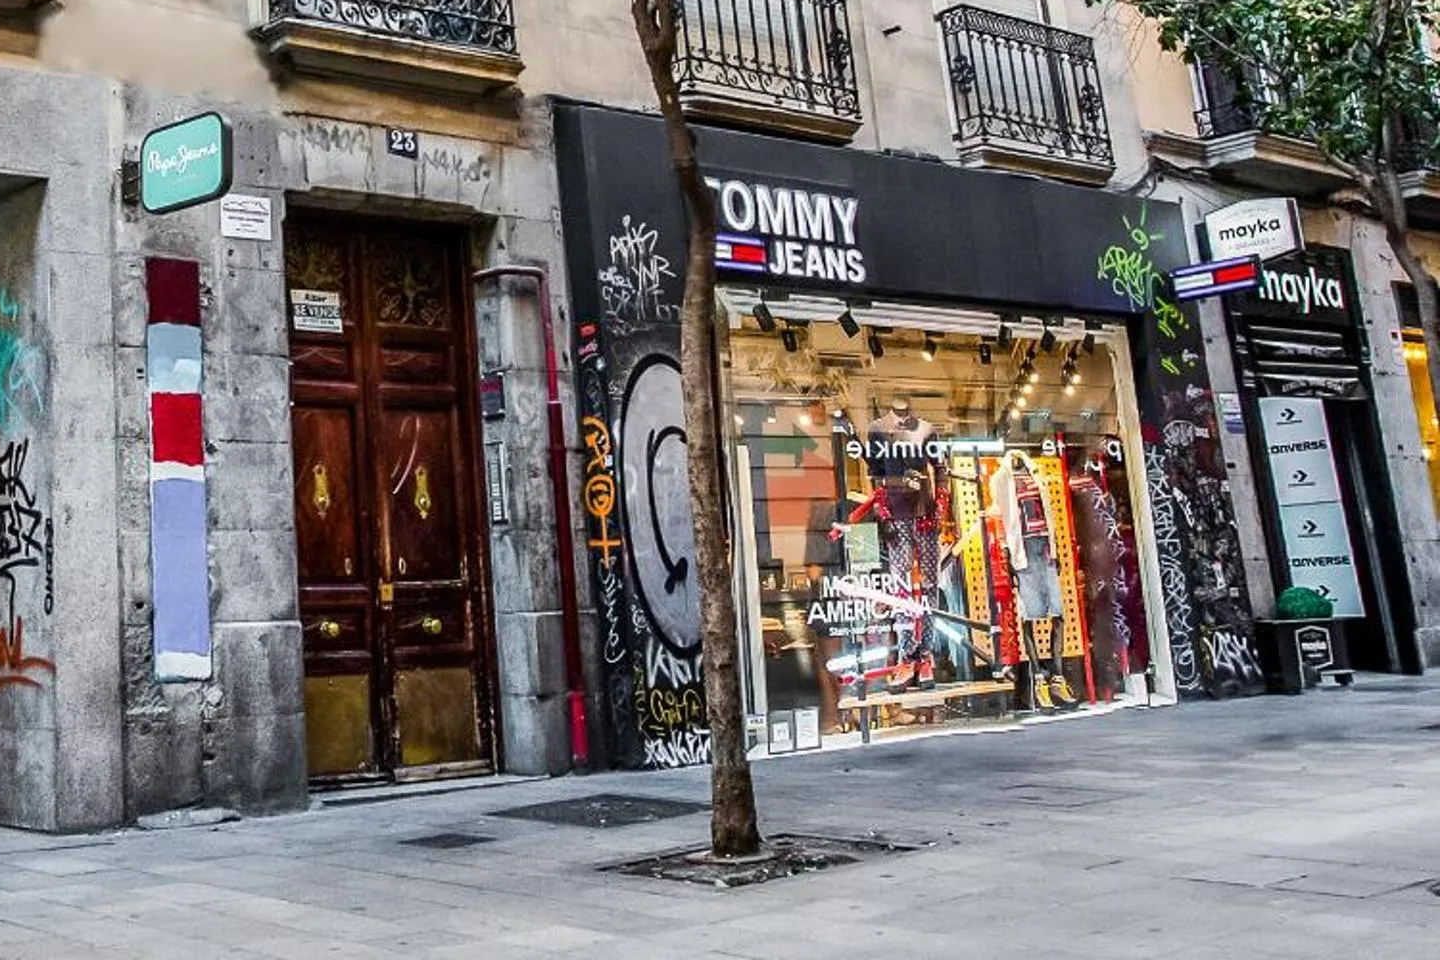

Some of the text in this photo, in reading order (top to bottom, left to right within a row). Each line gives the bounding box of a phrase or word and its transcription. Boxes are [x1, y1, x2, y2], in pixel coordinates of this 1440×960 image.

[390, 130, 416, 152] 23
[147, 142, 218, 177] Pepe Jeans
[1219, 218, 1281, 241] mayka
[769, 240, 866, 283] JEANS
[1259, 266, 1345, 314] mayka
[823, 573, 914, 597] MODERN
